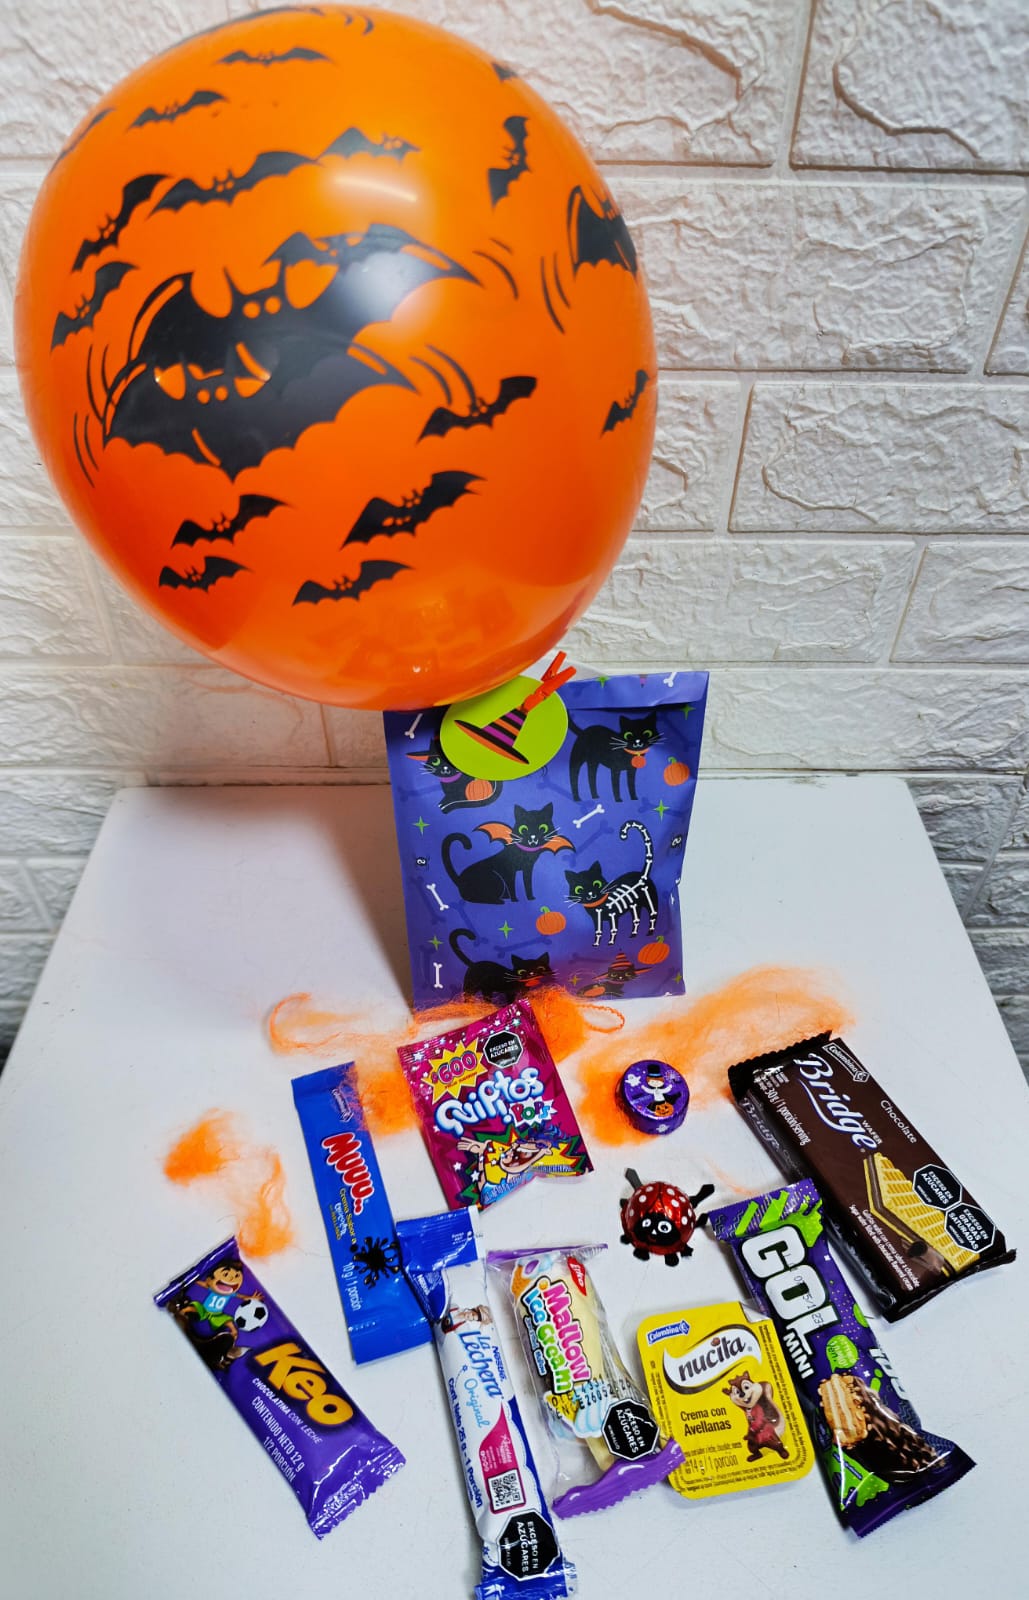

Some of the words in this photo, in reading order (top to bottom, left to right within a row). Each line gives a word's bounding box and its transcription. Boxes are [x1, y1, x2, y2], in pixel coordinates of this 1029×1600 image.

[794, 1053, 877, 1149] Bridge
[880, 1098, 917, 1144] Chocolate
[862, 1120, 882, 1145] WAFER
[949, 1212, 979, 1250] SATURADAS
[208, 1295, 226, 1309] 10
[741, 1224, 838, 1354] GOL
[477, 1334, 492, 1350] La
[523, 1289, 547, 1323] Ice
[536, 1322, 573, 1393] Cream
[542, 1282, 591, 1380] Mallow
[458, 1330, 502, 1398] Lechera
[678, 1336, 746, 1382] nucita
[782, 1331, 813, 1379] MINI
[253, 1340, 353, 1425] Keo
[465, 1377, 489, 1428] Original
[250, 1395, 283, 1437] CONTENIDO
[251, 1376, 290, 1415] CHOCOLATINA
[287, 1412, 302, 1425] CON
[300, 1424, 322, 1444] LECHE
[680, 1408, 709, 1421] Crema
[711, 1407, 727, 1417] con
[684, 1419, 732, 1437] Avellanas
[275, 1433, 295, 1455] NETO
[457, 1427, 466, 1441] 25
[636, 1435, 645, 1446] EN
[260, 1435, 275, 1450] 1/2
[269, 1448, 295, 1481] PORCIÓN
[288, 1450, 302, 1464] 12
[294, 1461, 306, 1472] g
[527, 1520, 538, 1556] EXCESO
[532, 1557, 538, 1568] EN
